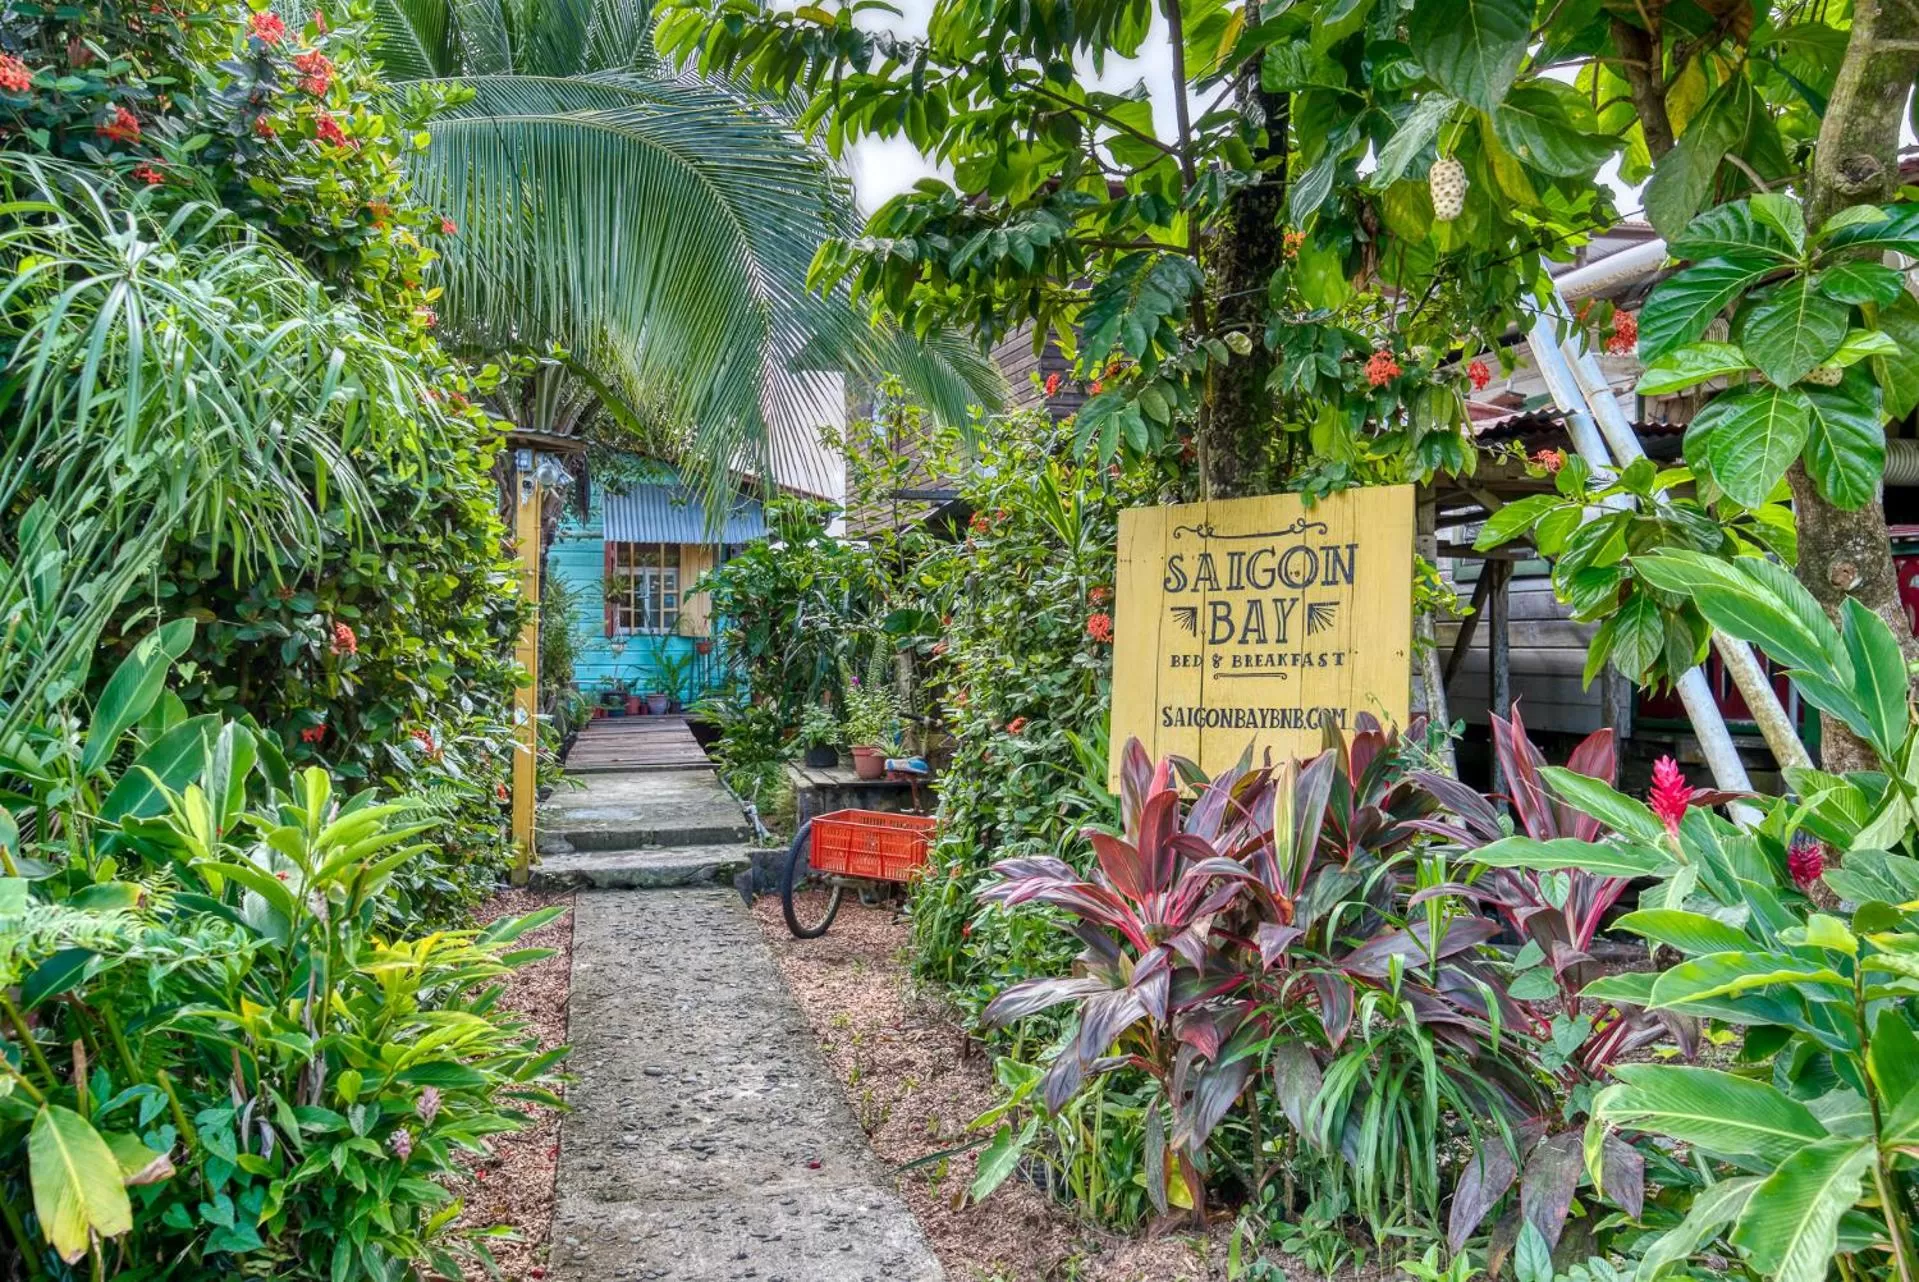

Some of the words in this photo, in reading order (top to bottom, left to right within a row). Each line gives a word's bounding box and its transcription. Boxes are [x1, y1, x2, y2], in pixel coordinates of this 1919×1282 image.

[1165, 544, 1358, 593] SAIGON
[1208, 597, 1299, 645] BAY
[1170, 655, 1203, 668] BED
[1212, 653, 1223, 669] &
[1231, 652, 1345, 669] BREAKFAST
